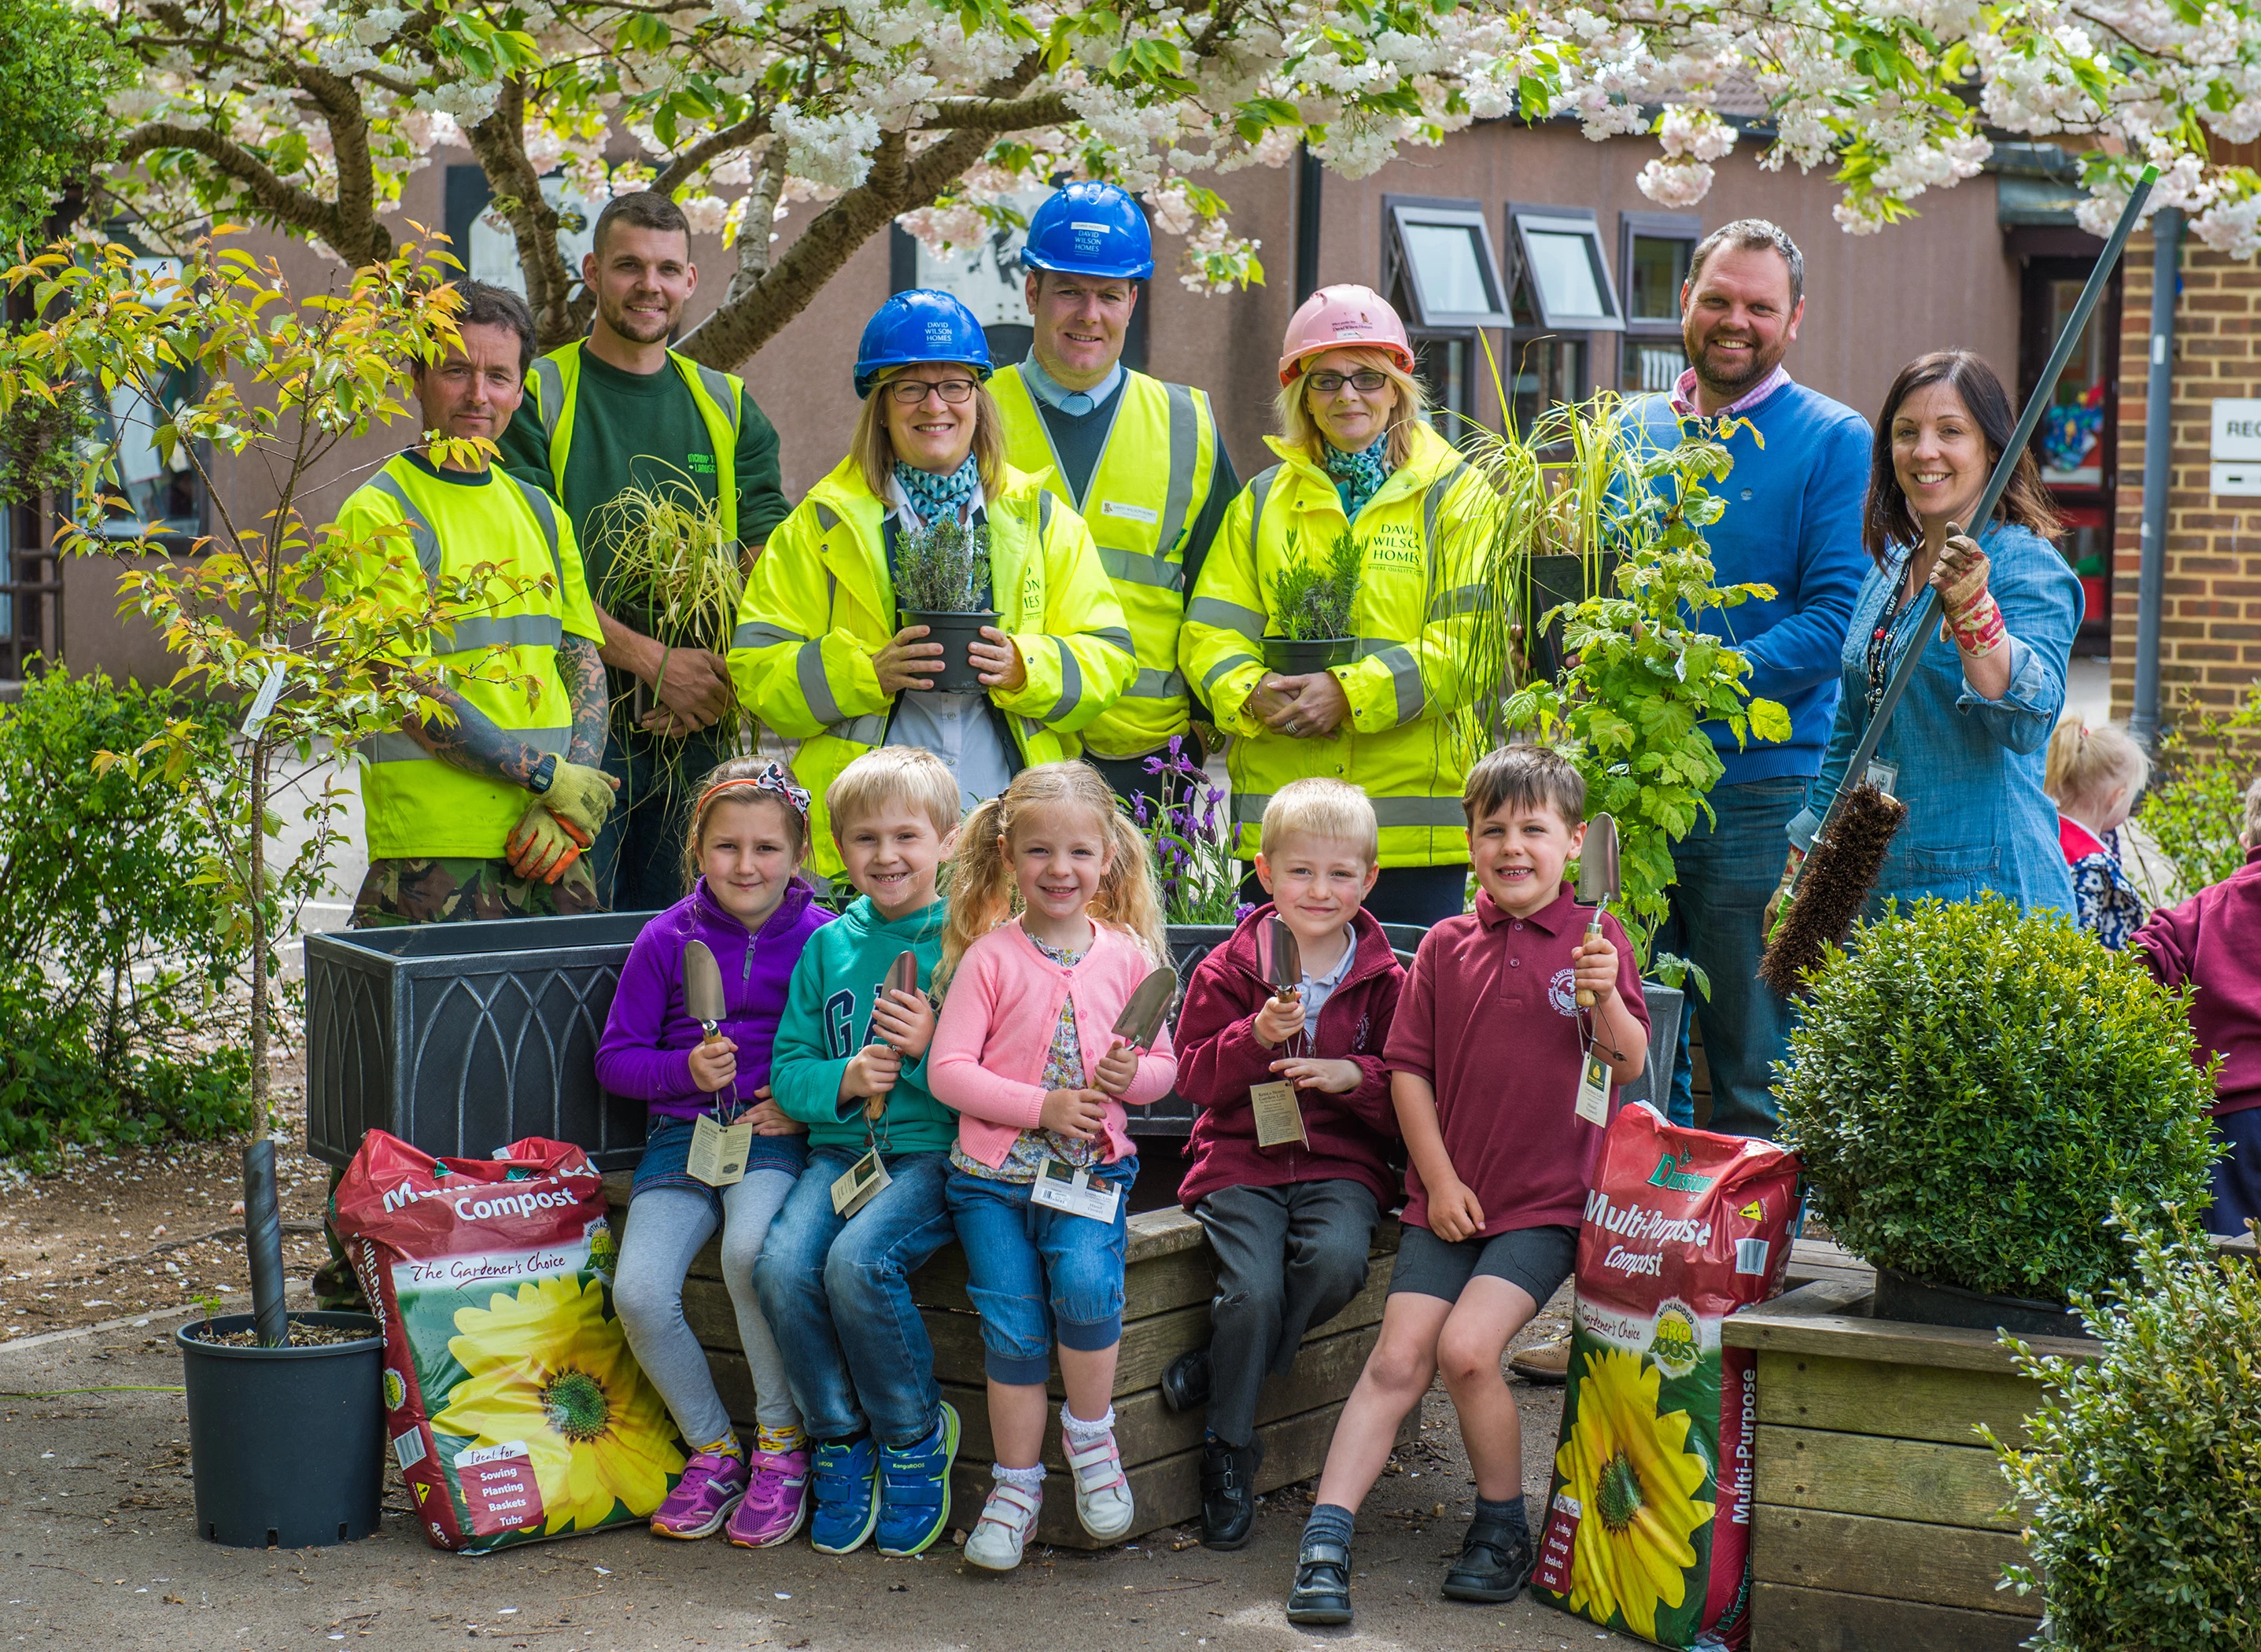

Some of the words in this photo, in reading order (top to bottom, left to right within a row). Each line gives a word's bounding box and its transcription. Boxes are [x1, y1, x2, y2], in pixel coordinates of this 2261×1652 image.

[1075, 237, 1101, 245] WILSON
[1381, 524, 1418, 540] DAVID
[1374, 550, 1419, 566] HOMES
[1886, 595, 1898, 616] STAFF
[455, 1186, 579, 1221] Compost
[1583, 1189, 1712, 1248] Multi-Purpose
[587, 1222, 599, 1237] WITH
[411, 1262, 444, 1282] The
[450, 1257, 522, 1280] Gardener's
[527, 1252, 566, 1273] Choice
[1603, 1245, 1663, 1278] Compost
[1582, 1304, 1617, 1336] Gardener's
[1618, 1318, 1640, 1340] Choice
[1658, 1303, 1673, 1318] WITH
[1673, 1304, 1695, 1325] ADDED
[1658, 1318, 1693, 1343] GRO
[1647, 1335, 1706, 1364] BOOST
[470, 1450, 497, 1464] Ideal
[500, 1445, 515, 1461] for
[1732, 1368, 1757, 1525] Multi-Purpose
[480, 1467, 518, 1481] Sowing
[481, 1482, 525, 1498] Planting
[488, 1498, 527, 1512] Baskets
[499, 1515, 523, 1527] Tubs
[1548, 1537, 1569, 1555] Planting
[1544, 1554, 1564, 1570] Baskets
[1544, 1572, 1557, 1586] Tubs
